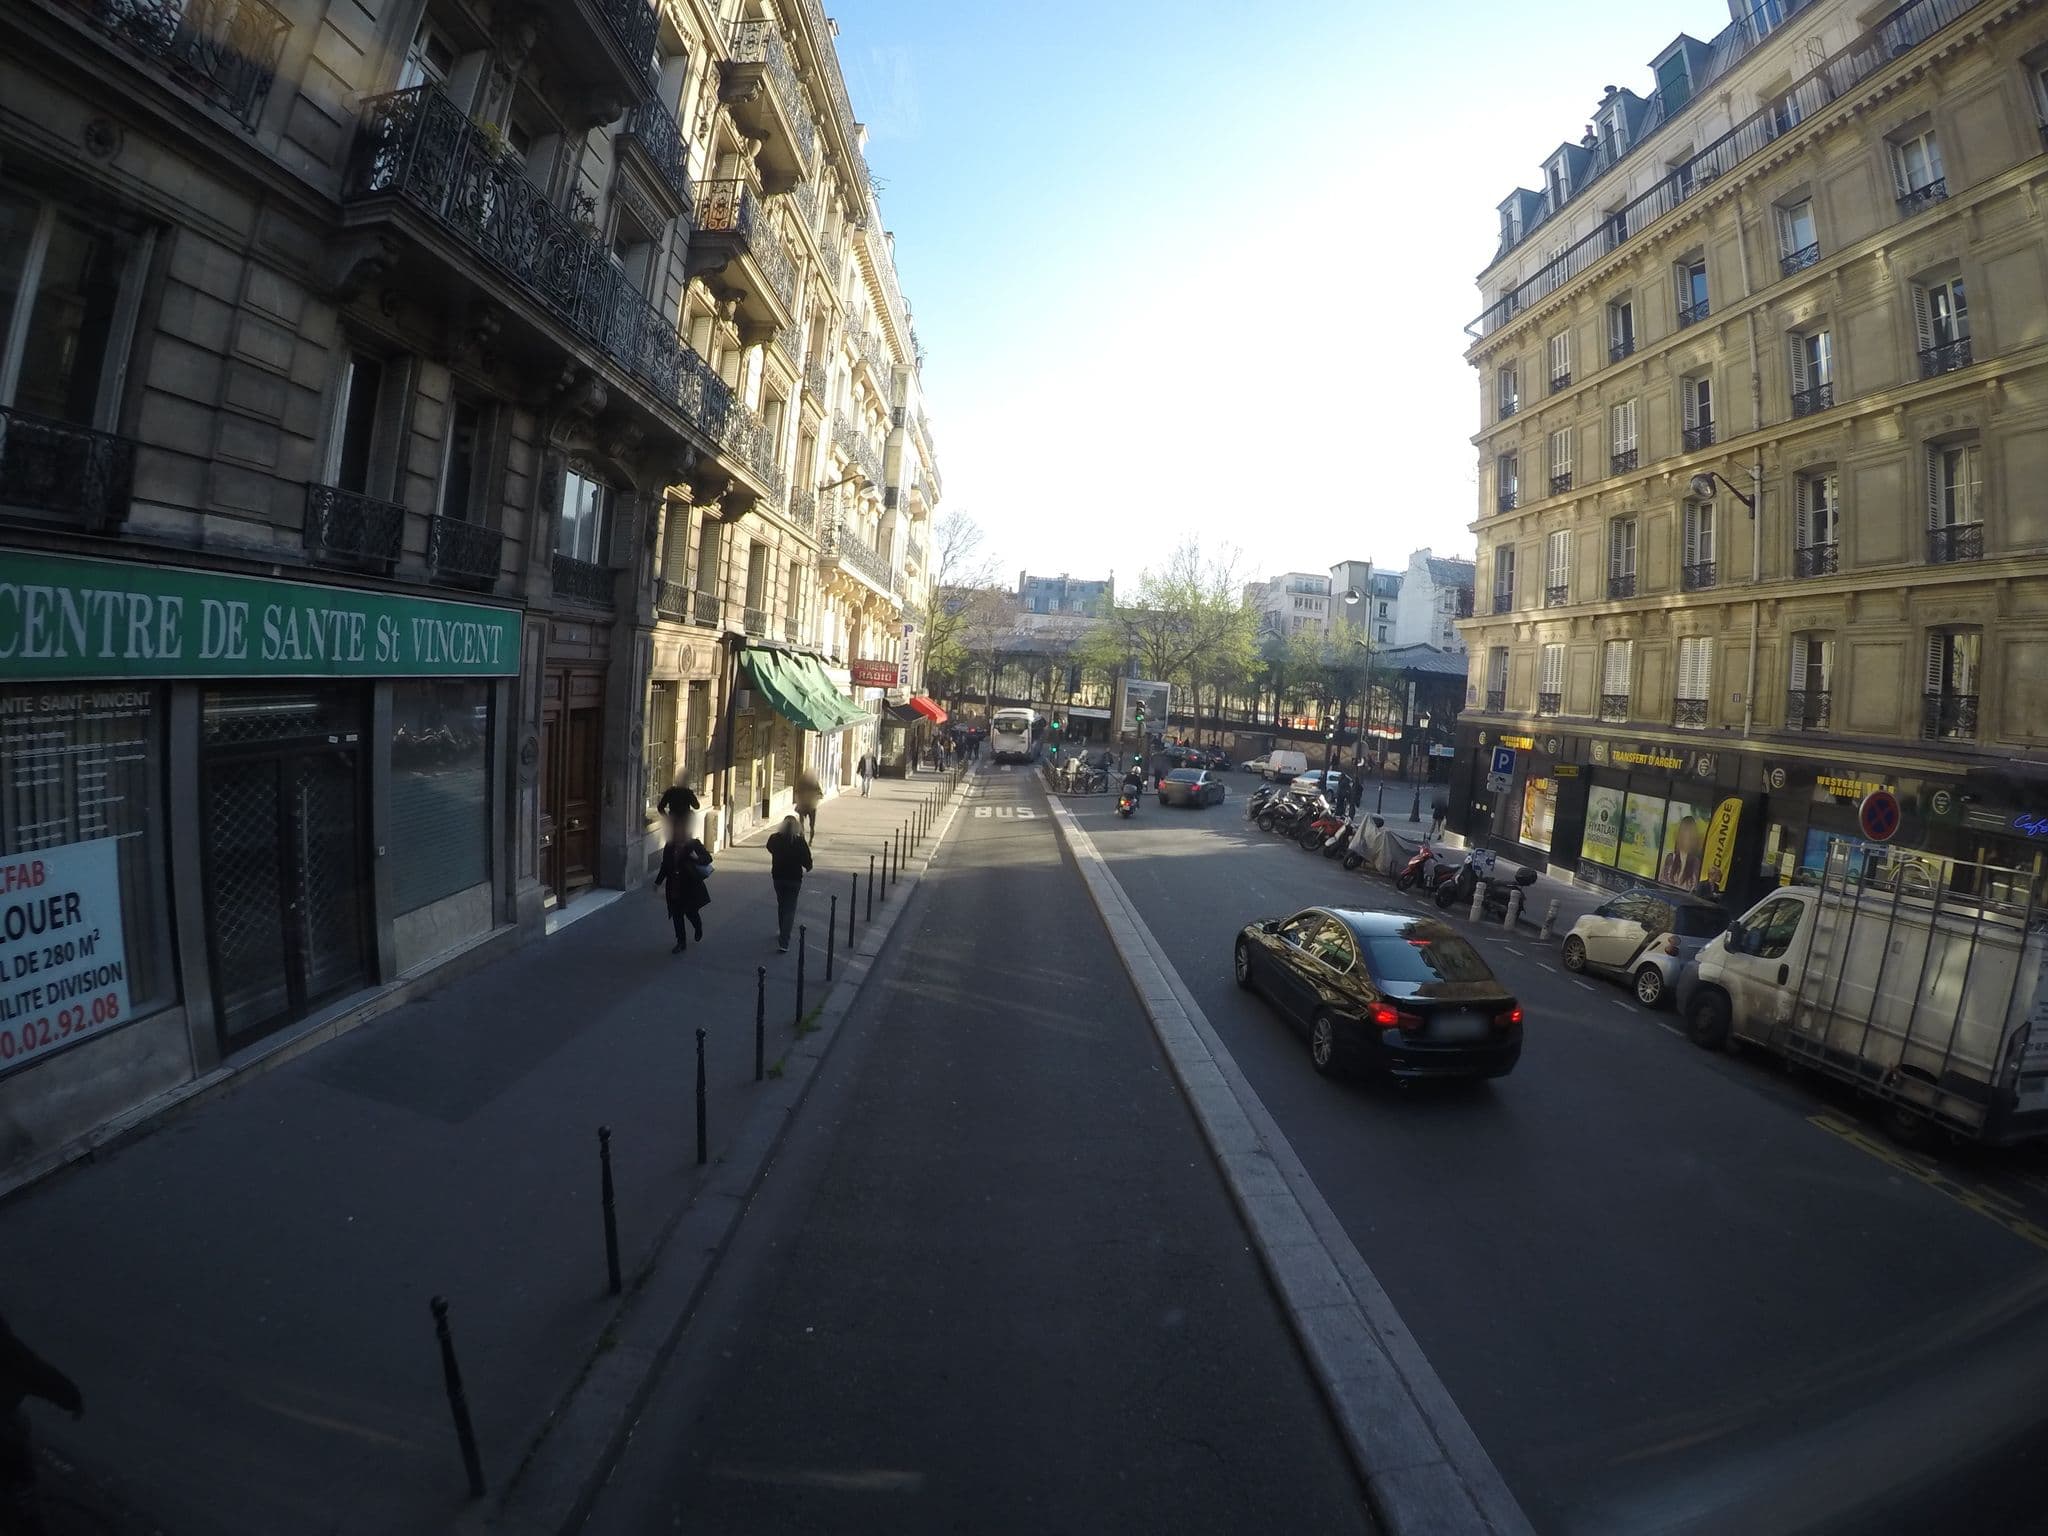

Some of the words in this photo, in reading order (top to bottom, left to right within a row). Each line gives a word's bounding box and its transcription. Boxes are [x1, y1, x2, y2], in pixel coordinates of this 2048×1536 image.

[0, 582, 184, 660] CENTRE
[198, 598, 249, 660] DE
[261, 604, 366, 662] SANTE
[375, 613, 400, 663] St
[411, 617, 503, 665] VINCENT
[859, 671, 892, 682] RADIO
[1499, 752, 1510, 769] P
[1612, 750, 1649, 765] TRANSFERT
[1648, 755, 1684, 770] D'ARGENT
[1816, 775, 1862, 791] WESTERN
[1829, 786, 1862, 799] UNION
[974, 806, 1035, 818] BUS
[14, 951, 39, 979] DE
[43, 942, 75, 970] 280
[47, 961, 123, 1006] DIVISION
